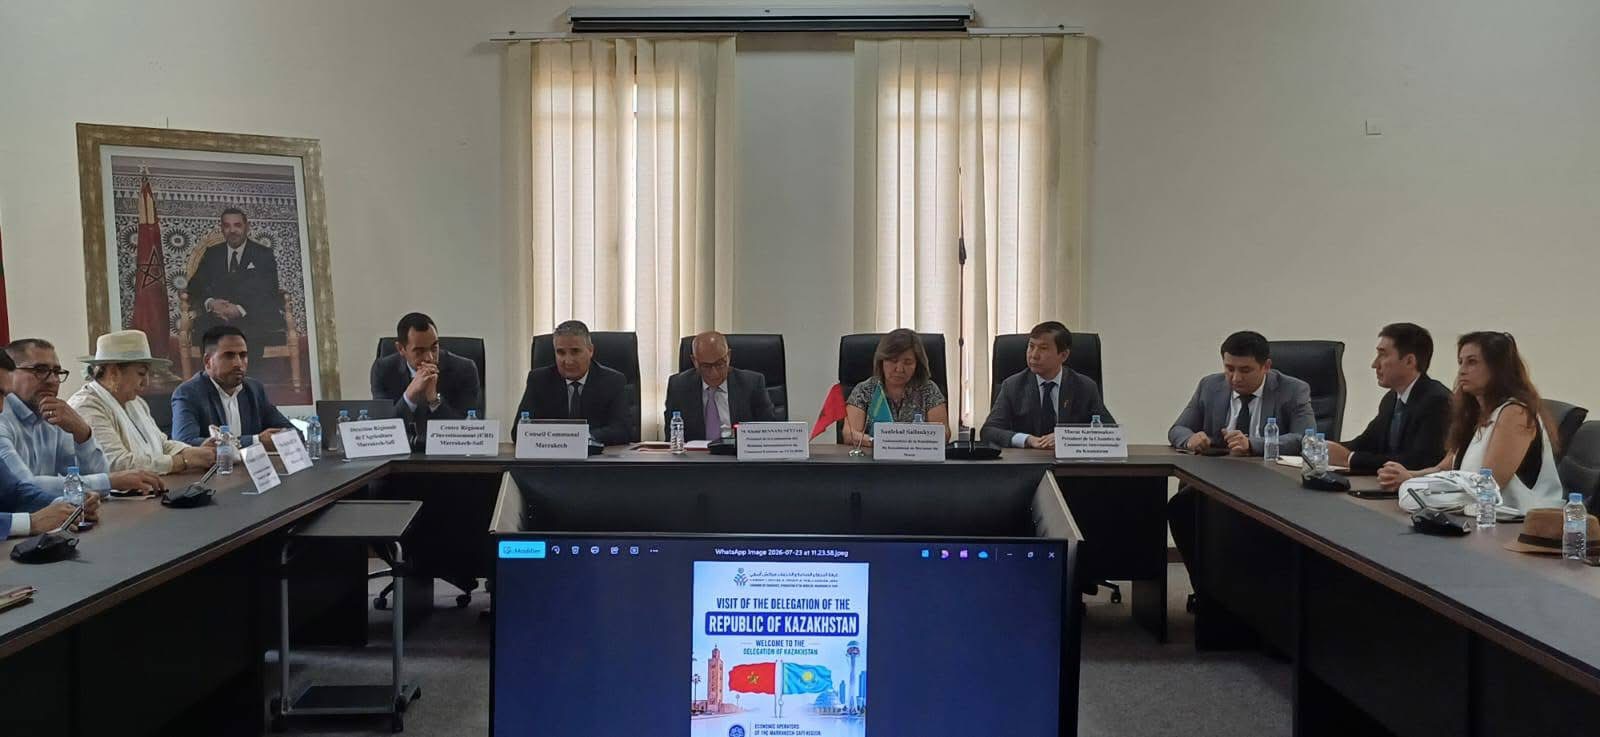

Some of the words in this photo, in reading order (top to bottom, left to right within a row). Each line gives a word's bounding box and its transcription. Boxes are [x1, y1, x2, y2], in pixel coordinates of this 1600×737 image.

[715, 548, 747, 557] WhatsApp
[748, 549, 767, 557] Image
[716, 597, 738, 609] VISIT
[740, 598, 750, 609] OF
[753, 598, 768, 609] THE
[771, 598, 819, 610] DELEGATION
[822, 599, 832, 610] OF
[836, 599, 850, 610] THE
[709, 615, 763, 633] REPUBLIC
[767, 616, 781, 633] OF
[784, 616, 857, 634] KAZAKHSTAN
